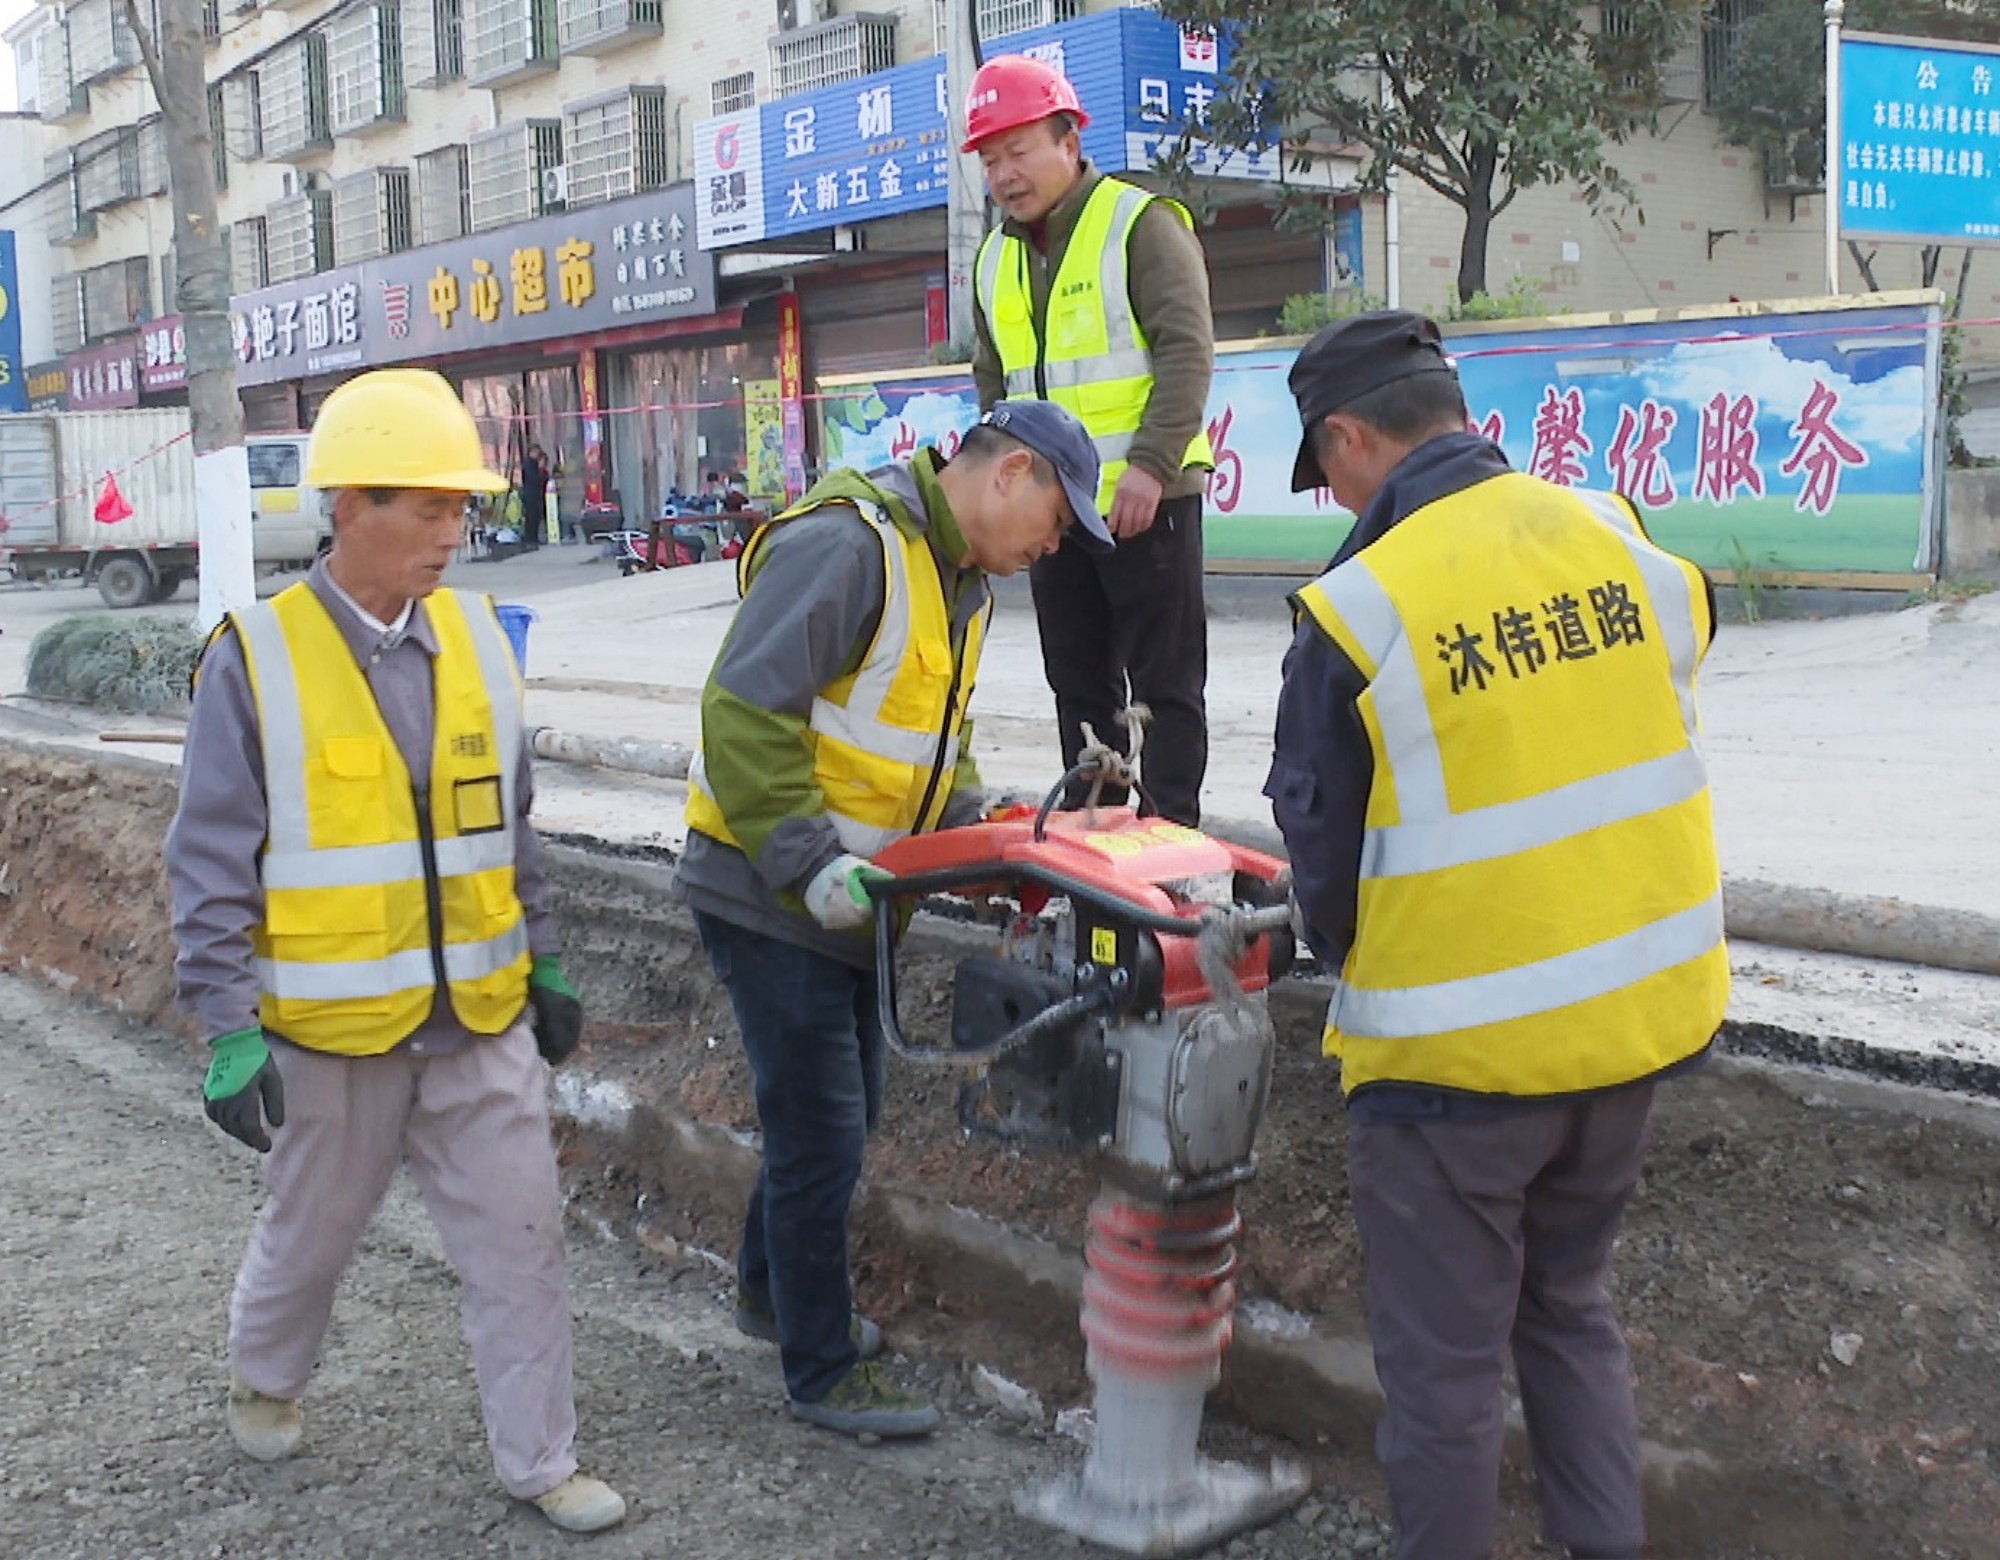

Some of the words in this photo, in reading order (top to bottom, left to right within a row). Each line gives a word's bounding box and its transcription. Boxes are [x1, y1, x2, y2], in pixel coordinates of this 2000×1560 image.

[1915, 60, 1993, 95] 公告
[787, 157, 903, 219] 大新五金
[428, 237, 598, 330] 中心超市
[1435, 579, 1646, 696] 沐伟道路
